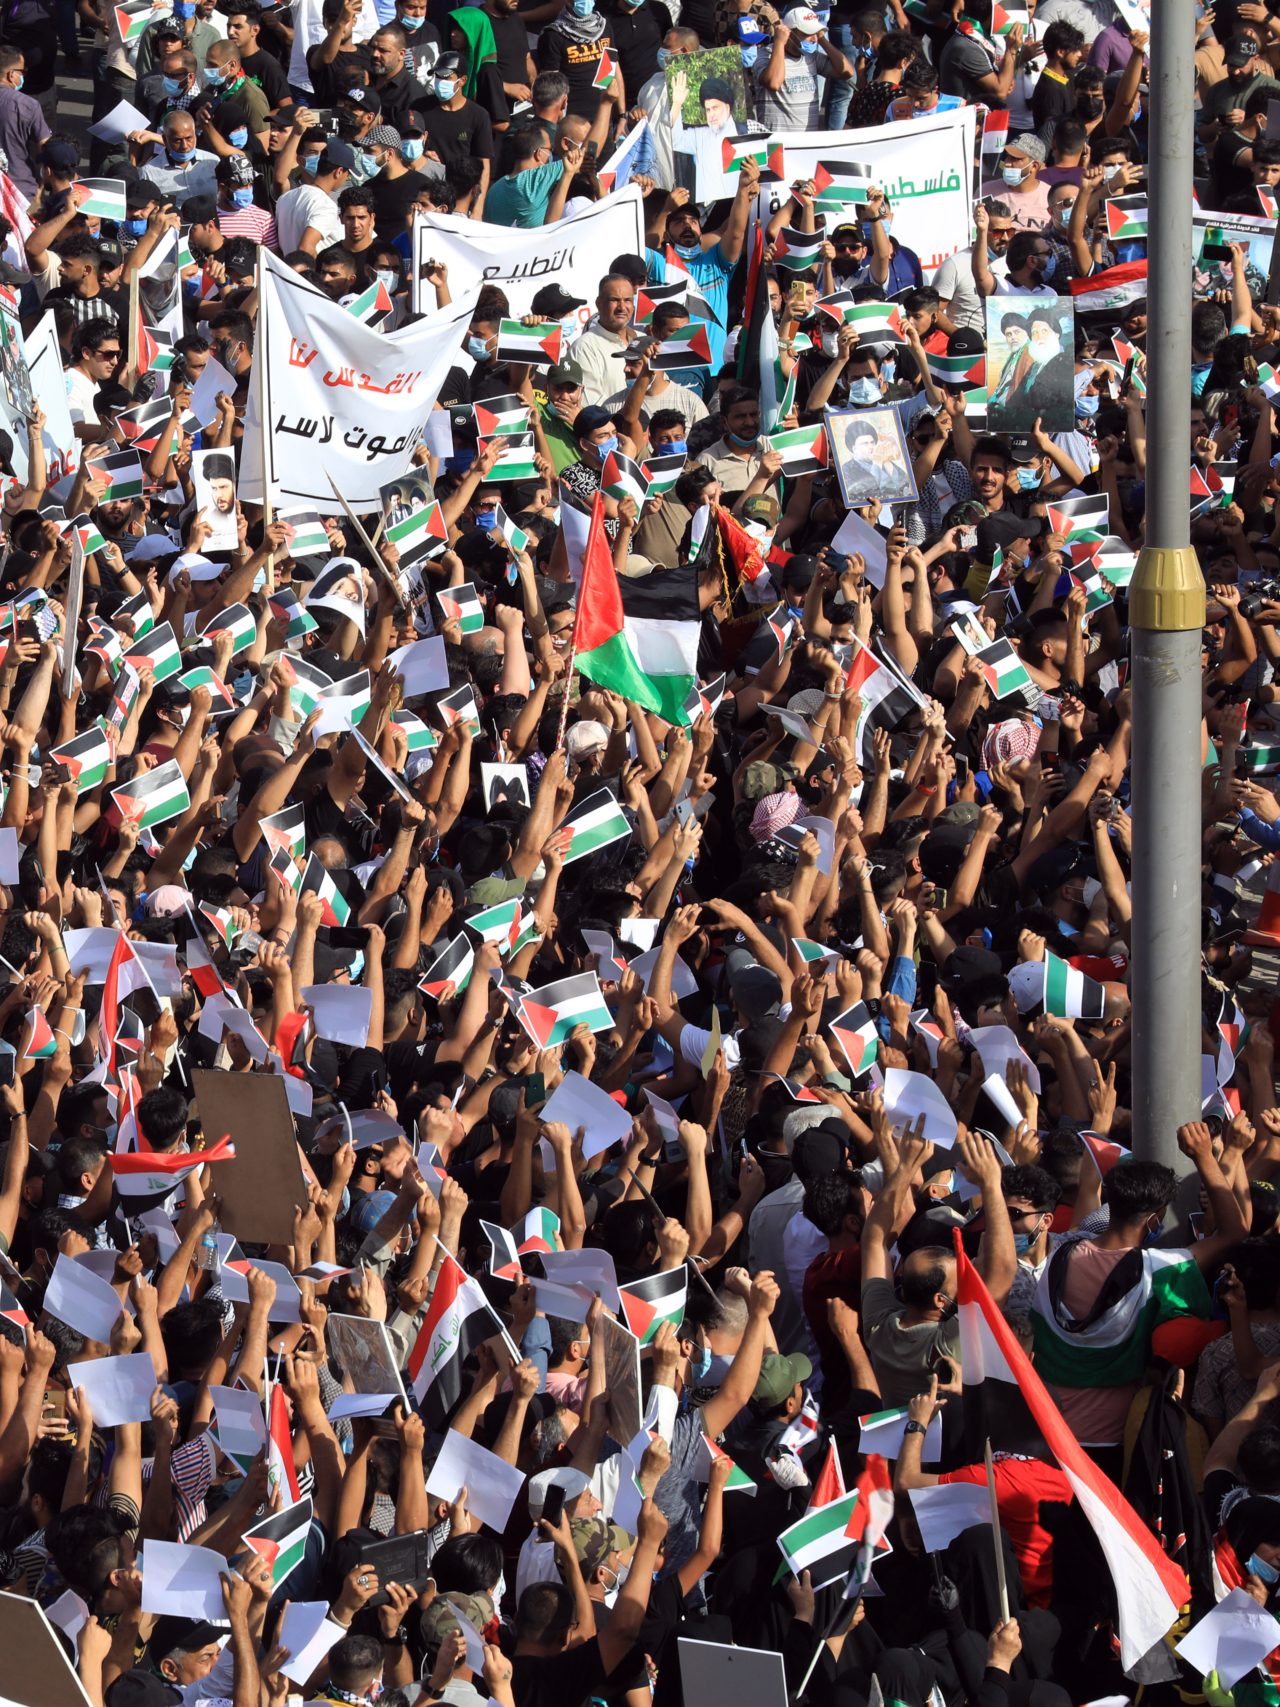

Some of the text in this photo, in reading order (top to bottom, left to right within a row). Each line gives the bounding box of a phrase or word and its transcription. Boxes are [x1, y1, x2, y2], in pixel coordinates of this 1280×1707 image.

[566, 42, 597, 58] 5.11
[482, 245, 576, 284] التطبيع
[289, 337, 422, 395] القدس لنا
